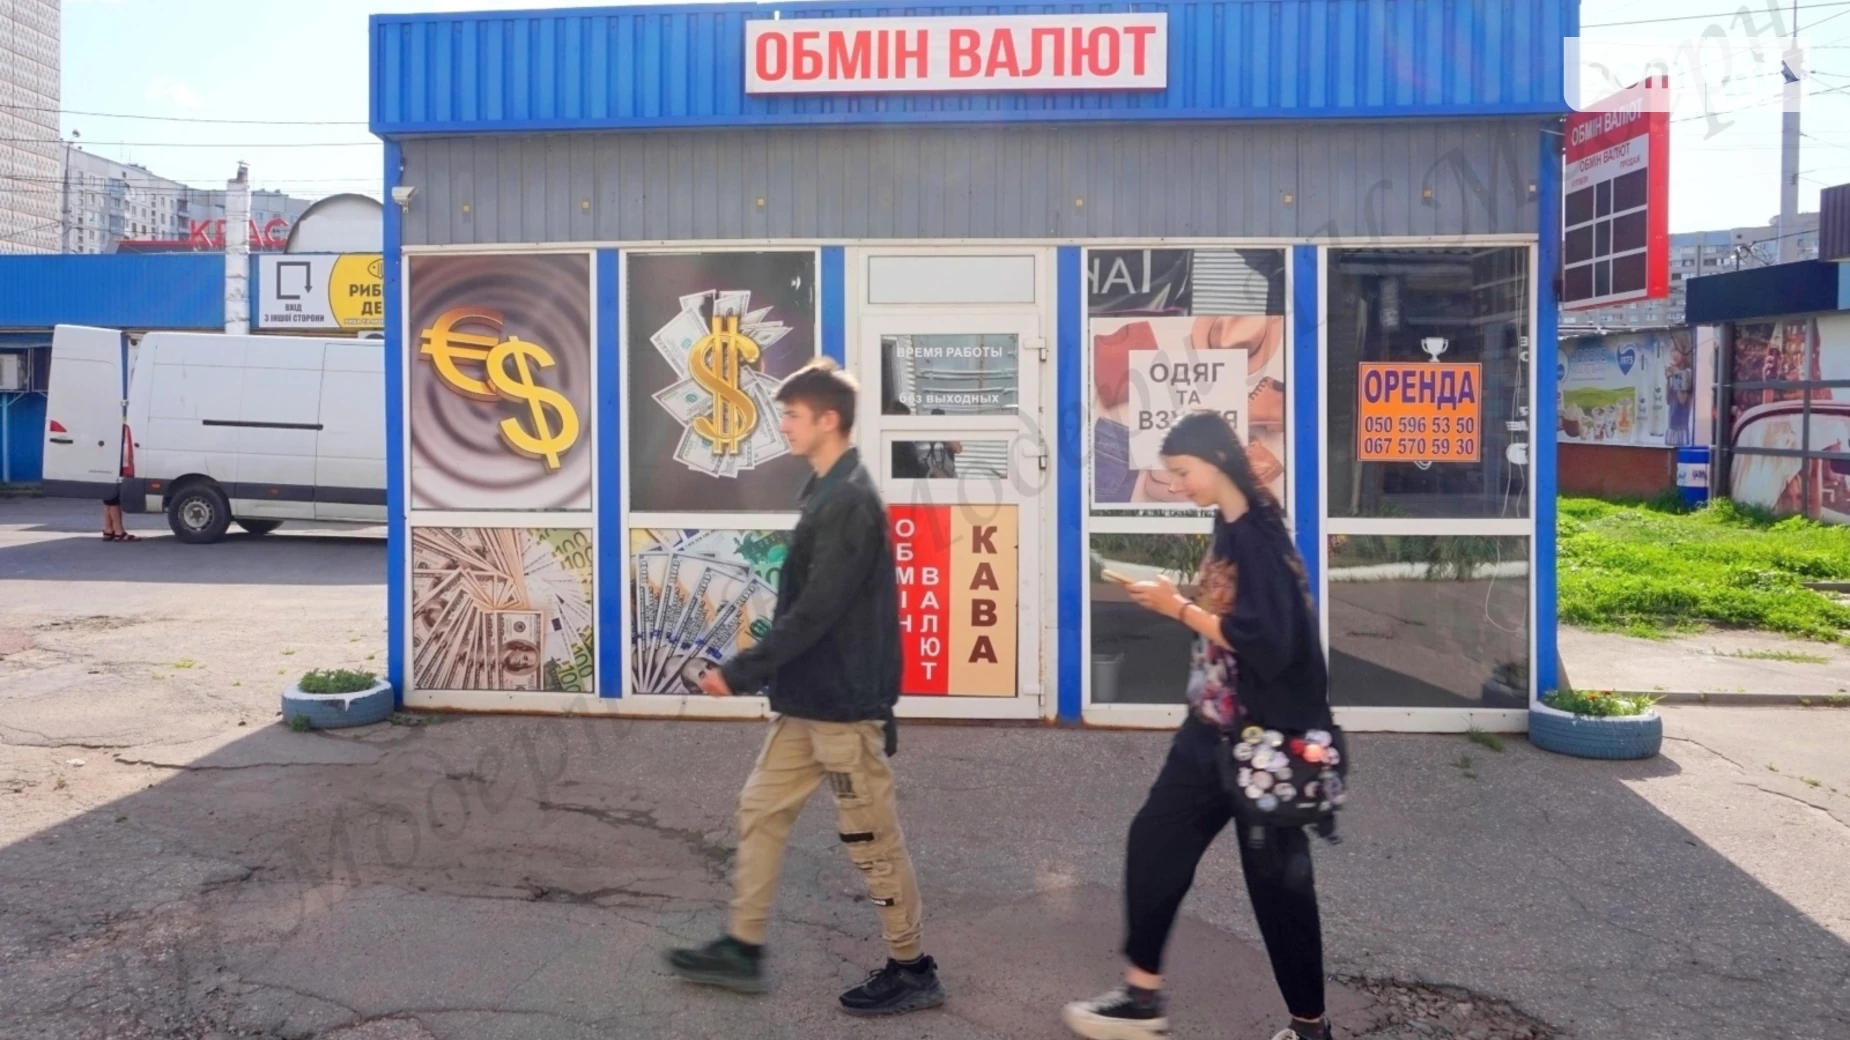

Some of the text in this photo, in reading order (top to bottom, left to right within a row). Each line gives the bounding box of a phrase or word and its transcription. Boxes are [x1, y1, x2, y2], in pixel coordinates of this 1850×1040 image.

[755, 26, 1157, 81] ОБМІН ВАЛЮТ
[1571, 97, 1644, 147] ОБМІН ВАЛЮТ
[1579, 142, 1631, 172] ОБМІН ВАЛЮТ
[293, 314, 325, 322] СТОРОНИ
[896, 347, 1003, 358] ВРЕМЯ РАБОТЫ
[1149, 362, 1225, 386] ОДЯГ
[899, 393, 1000, 404] без выходных
[1176, 390, 1201, 405] ТА
[1364, 369, 1476, 411] ОРЕНДА
[1364, 416, 1474, 434] 050 596 53 50
[1364, 437, 1474, 455] 067 570 59 30
[895, 519, 941, 680] ОБМІН ВАЛЮТ
[968, 525, 1000, 664] КАВА
